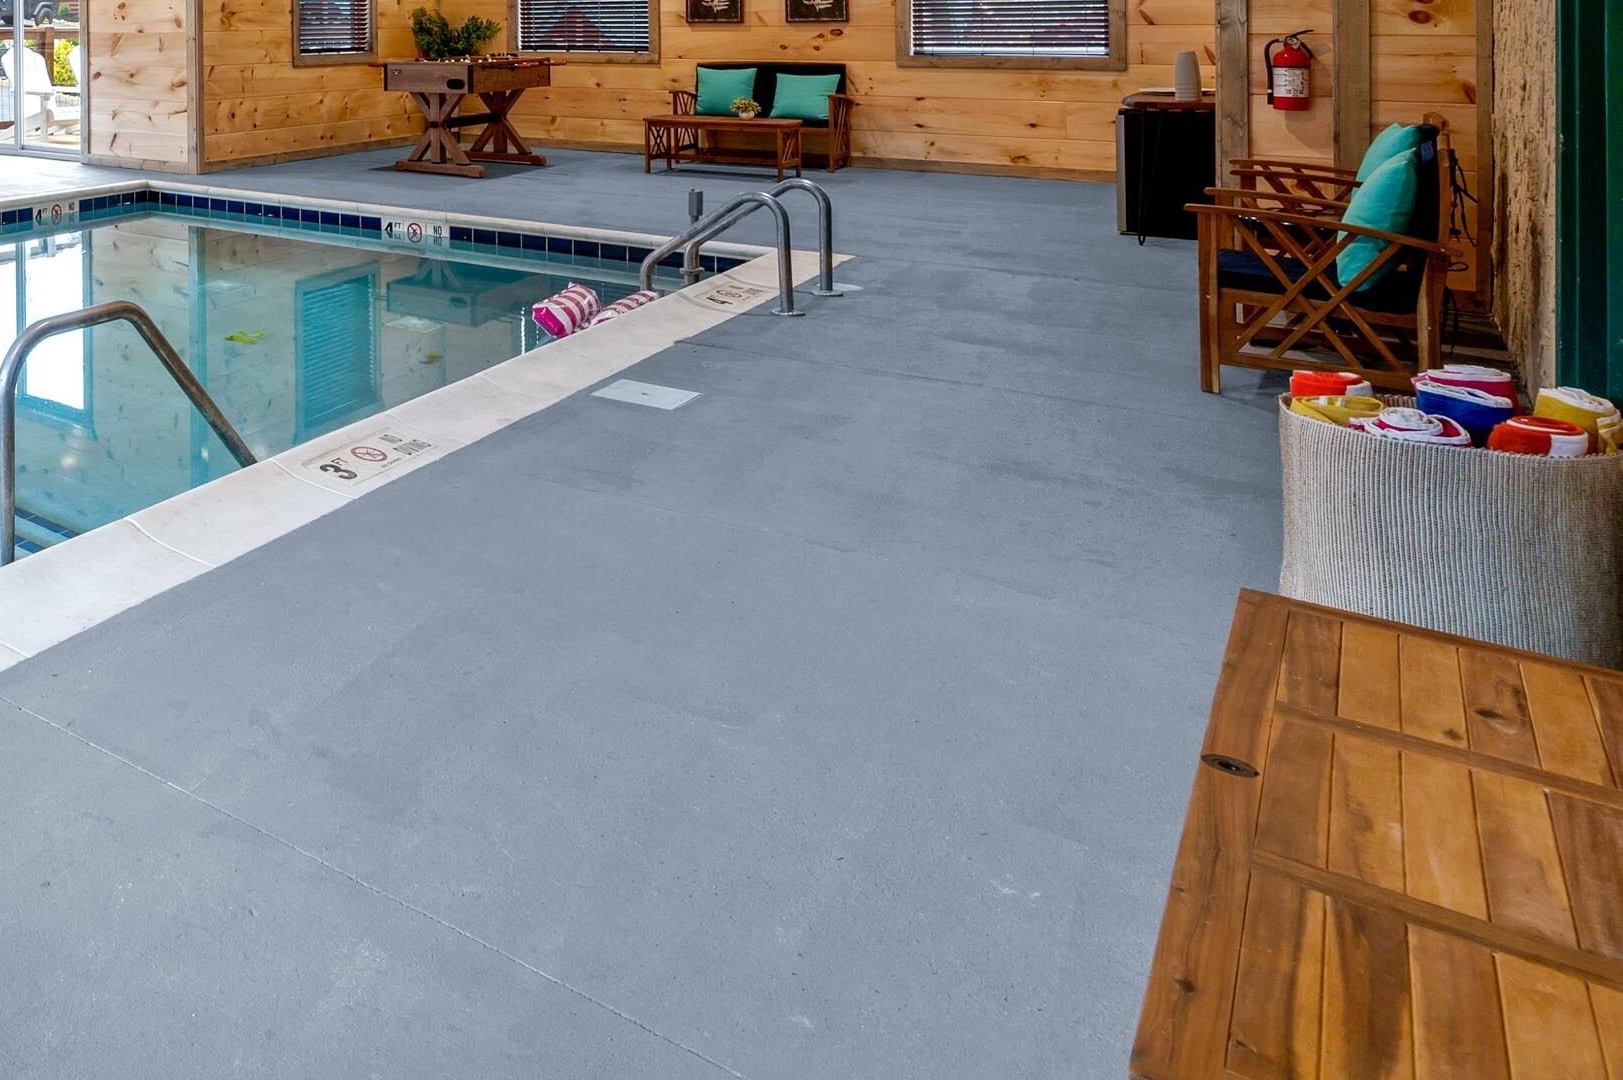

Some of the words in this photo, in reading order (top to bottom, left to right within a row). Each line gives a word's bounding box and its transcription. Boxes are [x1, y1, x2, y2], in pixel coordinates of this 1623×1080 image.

[433, 225, 443, 236] NO
[331, 457, 349, 466] FT
[319, 463, 357, 480] 3
